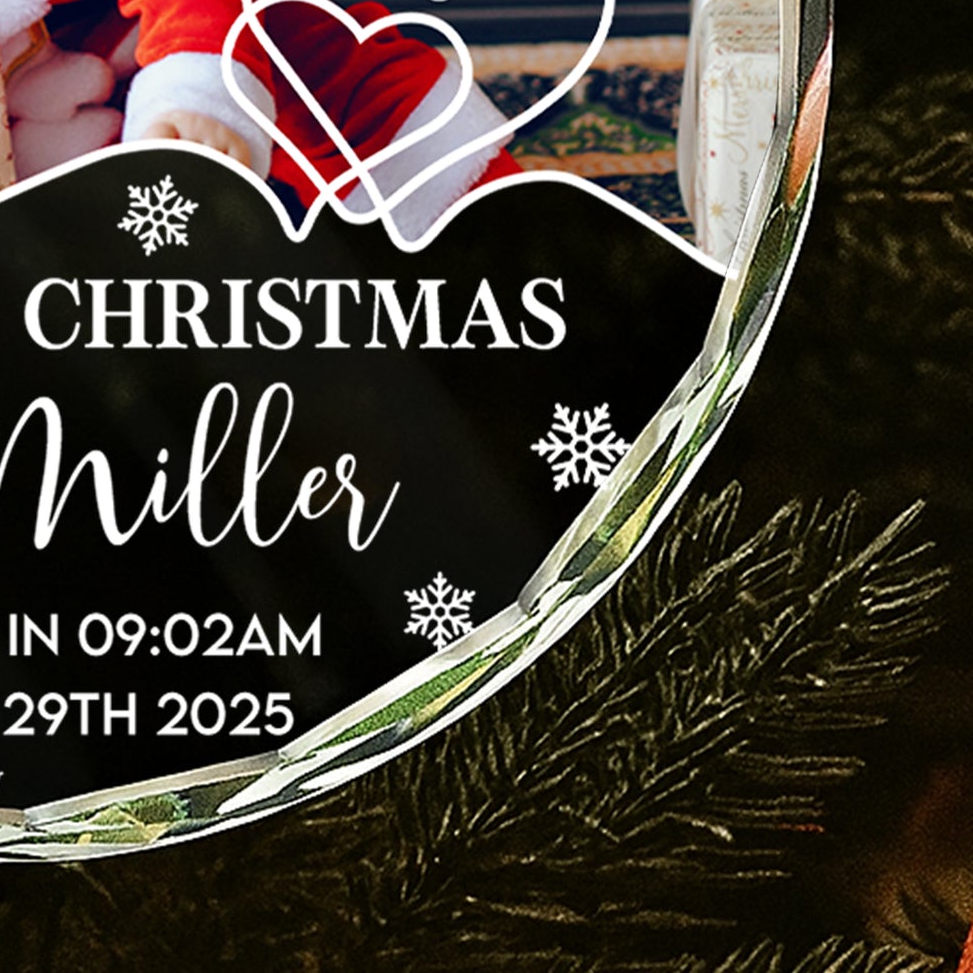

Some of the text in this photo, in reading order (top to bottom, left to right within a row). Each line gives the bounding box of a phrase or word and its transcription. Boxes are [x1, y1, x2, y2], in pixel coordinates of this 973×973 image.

[23, 277, 567, 351] CHRISTMAS
[9, 613, 59, 656] IN
[78, 612, 321, 657] 09:02AM
[3, 691, 137, 736] 29TH
[156, 691, 295, 736] 2025
